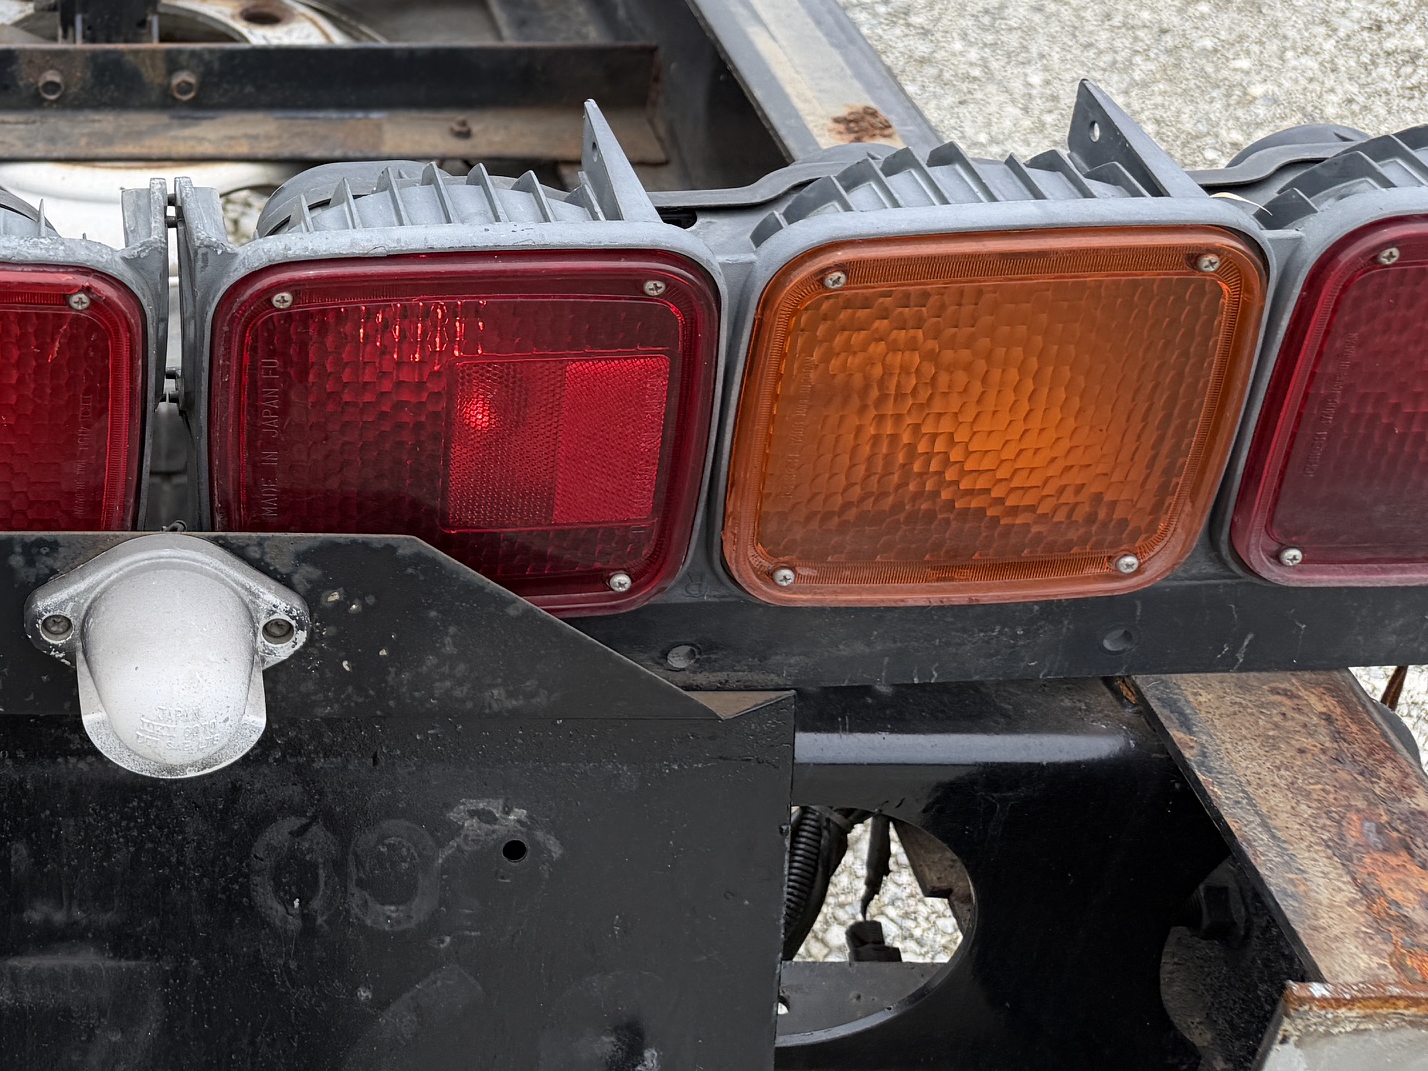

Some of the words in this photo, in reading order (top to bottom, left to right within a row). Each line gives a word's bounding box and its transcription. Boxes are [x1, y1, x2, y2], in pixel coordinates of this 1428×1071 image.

[260, 388, 278, 437] JAPAN
[261, 450, 277, 465] IN
[260, 477, 277, 516] MADE
